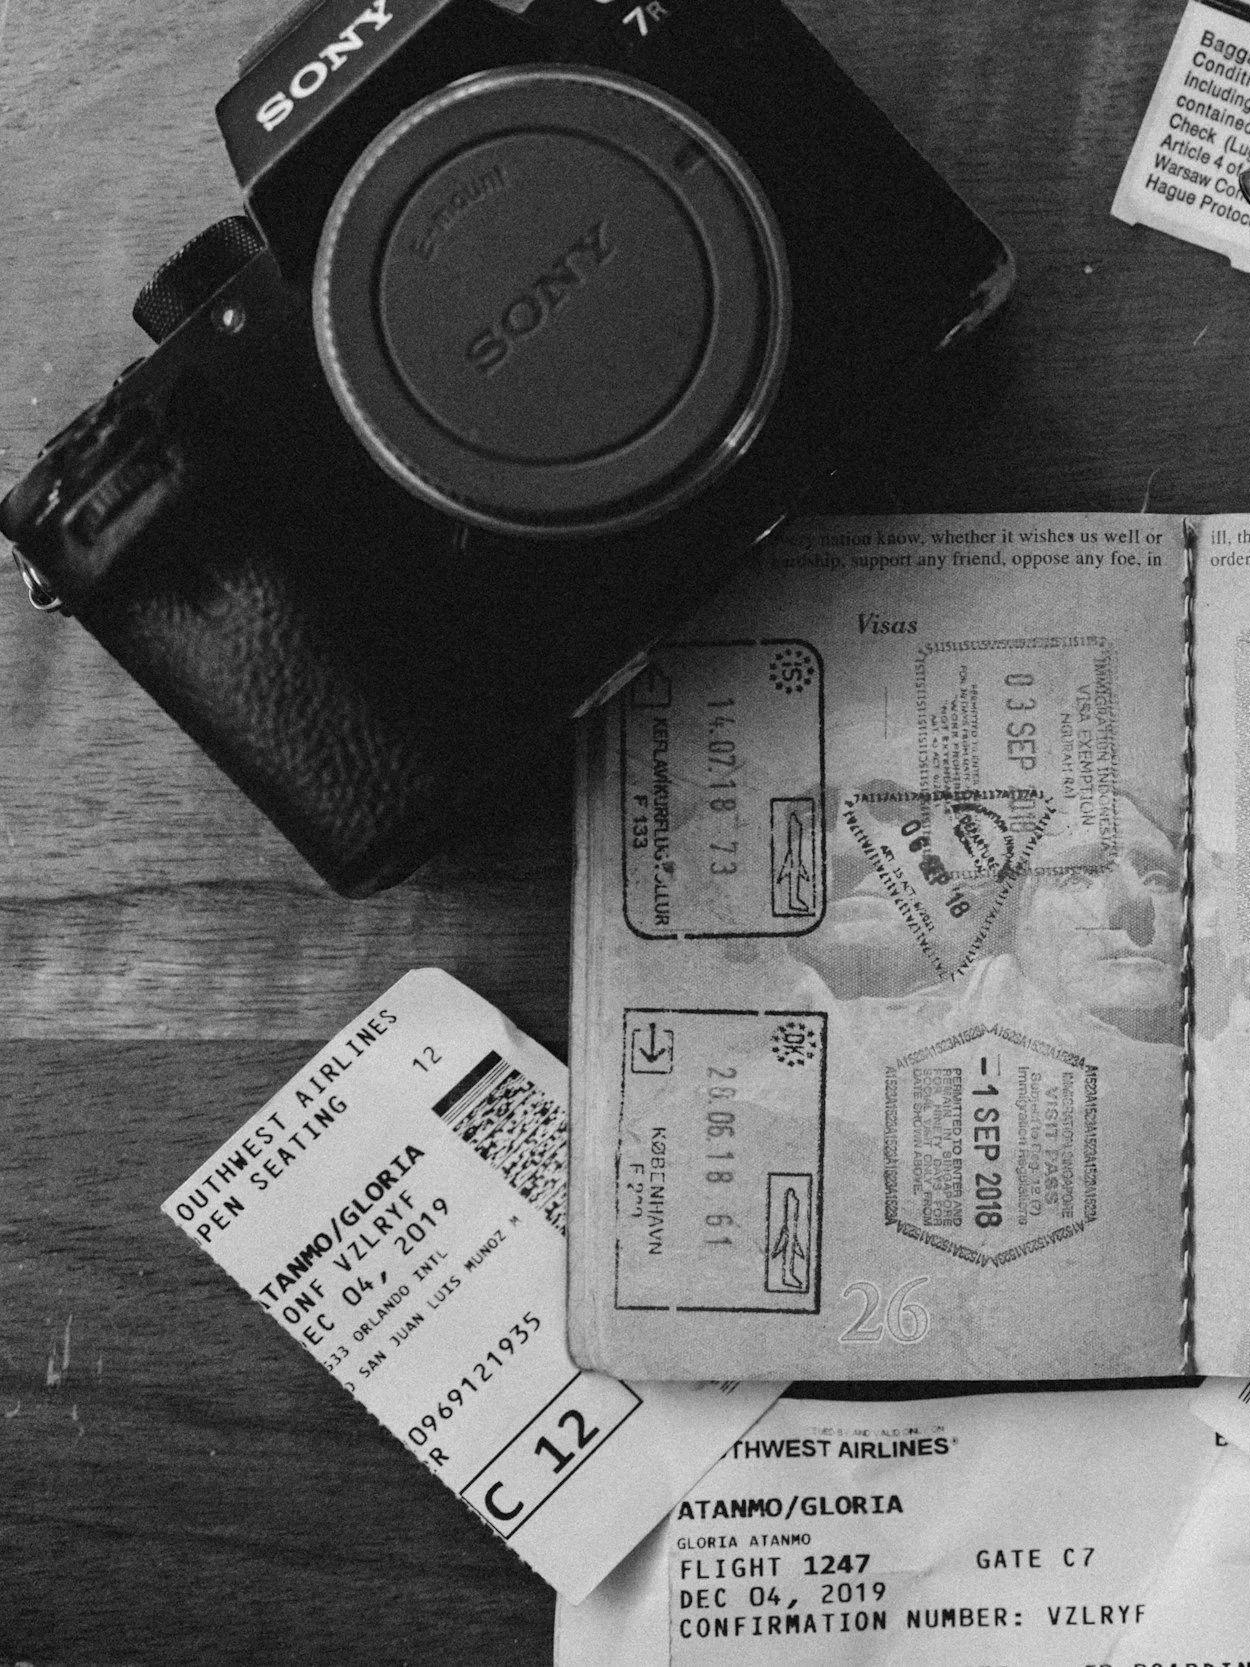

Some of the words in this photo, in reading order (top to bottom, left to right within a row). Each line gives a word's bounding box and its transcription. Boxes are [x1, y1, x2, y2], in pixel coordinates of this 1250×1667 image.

[256, 0, 393, 131] SONY
[1160, 133, 1211, 166] Article
[1169, 112, 1218, 145] Check
[1144, 173, 1196, 206] Hague
[1153, 152, 1212, 188] Warsaw
[464, 218, 624, 376] SONY
[877, 530, 926, 547] know,
[931, 529, 998, 545] whether
[1019, 529, 1074, 544] wishes
[1080, 532, 1098, 544] us
[1104, 529, 1141, 544] well
[1145, 532, 1163, 545] or
[851, 552, 912, 571] support
[918, 555, 948, 570] any
[952, 551, 1007, 568] friend,
[1012, 554, 1071, 569] oppose
[1076, 555, 1103, 569] any
[1110, 551, 1142, 568] foe,
[856, 613, 919, 635] Visas
[632, 815, 649, 850] 133
[411, 1045, 443, 1076] 12
[782, 1033, 806, 1057] DK
[175, 1111, 287, 1222] OUTHWEST
[294, 1008, 398, 1109] AIRLINES
[952, 1067, 963, 1136] PERMITTED
[973, 1107, 1000, 1161] SEP
[196, 1195, 246, 1243] PEN
[249, 1095, 348, 1191] SEATING
[647, 1126, 667, 1256] KØBENHAVN
[974, 1172, 1003, 1229] 2018
[393, 1197, 449, 1256] 2019
[281, 1277, 326, 1326] ONF
[332, 1188, 415, 1273] VZLRYF
[352, 1284, 412, 1344] ORLANDO
[411, 1249, 450, 1283] INTL
[358, 1349, 388, 1379] SAN
[388, 1311, 426, 1348] JUAN
[426, 1275, 462, 1311] LUIS
[463, 1228, 508, 1274] MUNOZ
[837, 1274, 932, 1346] 26
[406, 1310, 542, 1447] 0969121935
[483, 1480, 525, 1523] C
[533, 1408, 601, 1475] 12
[677, 1494, 904, 1521] ATANMO/GLORIA
[676, 1535, 739, 1551] GLORIA
[749, 1532, 813, 1547] ATANMO
[680, 1556, 782, 1581] FLIGHT
[803, 1553, 872, 1576] 1247
[975, 1548, 1042, 1571] GATE
[1063, 1547, 1097, 1568] C7
[680, 1587, 728, 1610] DEC
[749, 1585, 798, 1611] 04,
[820, 1581, 887, 1604] 2019
[679, 1609, 888, 1639] CONFIRMATION
[906, 1606, 1024, 1631] NUMBER:
[1047, 1603, 1147, 1627] VZLRYF
